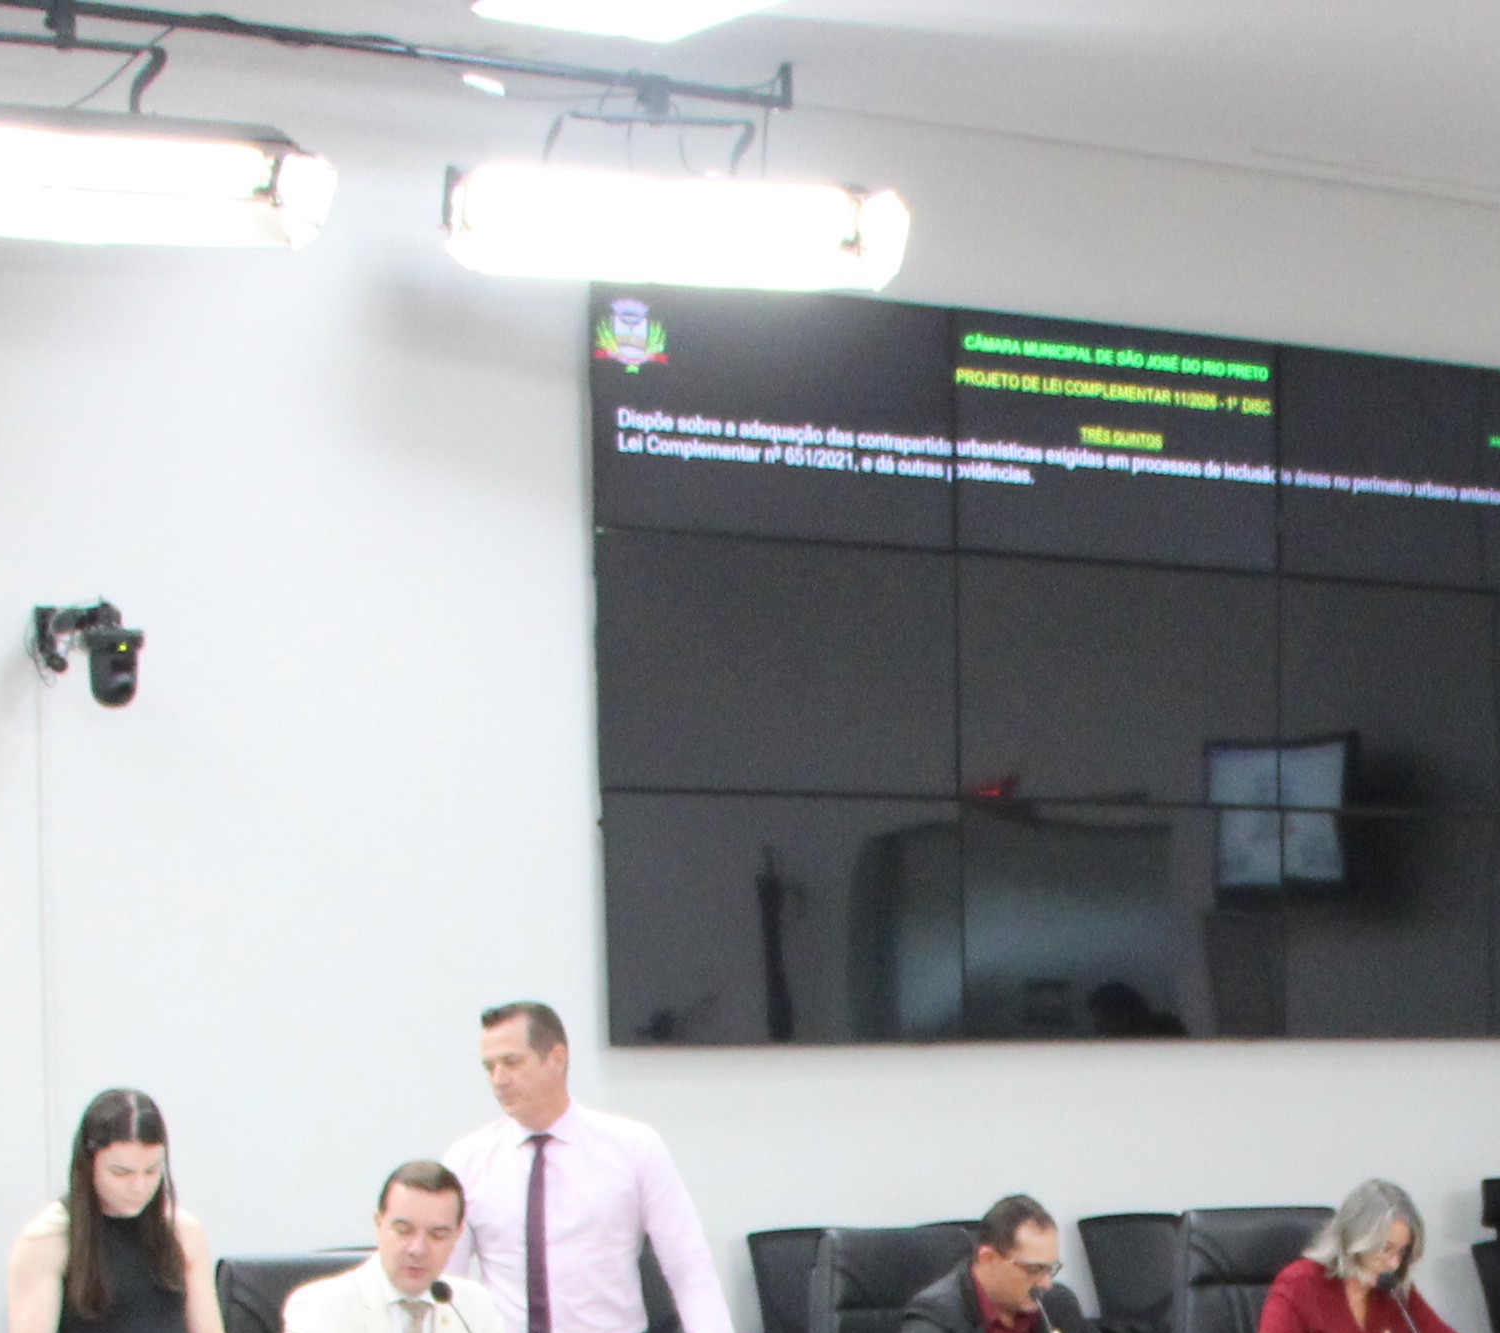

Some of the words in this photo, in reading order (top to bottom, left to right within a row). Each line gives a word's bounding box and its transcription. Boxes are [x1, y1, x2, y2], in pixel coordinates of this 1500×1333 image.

[964, 333, 1021, 355] CÂMARA
[1024, 339, 1093, 363] MUNICIPAL
[1095, 348, 1114, 365] DE
[1116, 348, 1144, 369] SÃO
[1146, 353, 1179, 372] JOSÉ
[1181, 356, 1201, 374] DO
[1203, 359, 1225, 376] RIO
[1227, 361, 1269, 382] PRETO
[956, 367, 1020, 390] PROJETO
[1021, 373, 1040, 393] DE
[1043, 376, 1062, 395] LEI
[1064, 378, 1172, 405] COMPLEMENTAR
[617, 408, 674, 434] Dispõe
[677, 415, 723, 436] sobre
[725, 423, 736, 437] a
[739, 420, 823, 447] adequação
[826, 427, 855, 449] das
[957, 439, 1043, 463] urbanísticas
[1045, 447, 1104, 470] exigidas
[1107, 454, 1129, 470] em
[1132, 456, 1200, 476] processos
[1204, 458, 1221, 477] de
[1294, 468, 1332, 489] áreas
[1334, 475, 1350, 490] no
[1353, 474, 1412, 495] perímetro
[1415, 480, 1457, 498] urbano
[617, 431, 643, 453] Lei
[646, 434, 762, 463] Complementar
[784, 446, 859, 473] 651/2021,
[861, 459, 872, 472] e
[875, 456, 895, 475] dá
[898, 460, 943, 479] outras
[1080, 425, 1111, 447] TRÊS
[1112, 430, 1164, 451] QUINTOS
